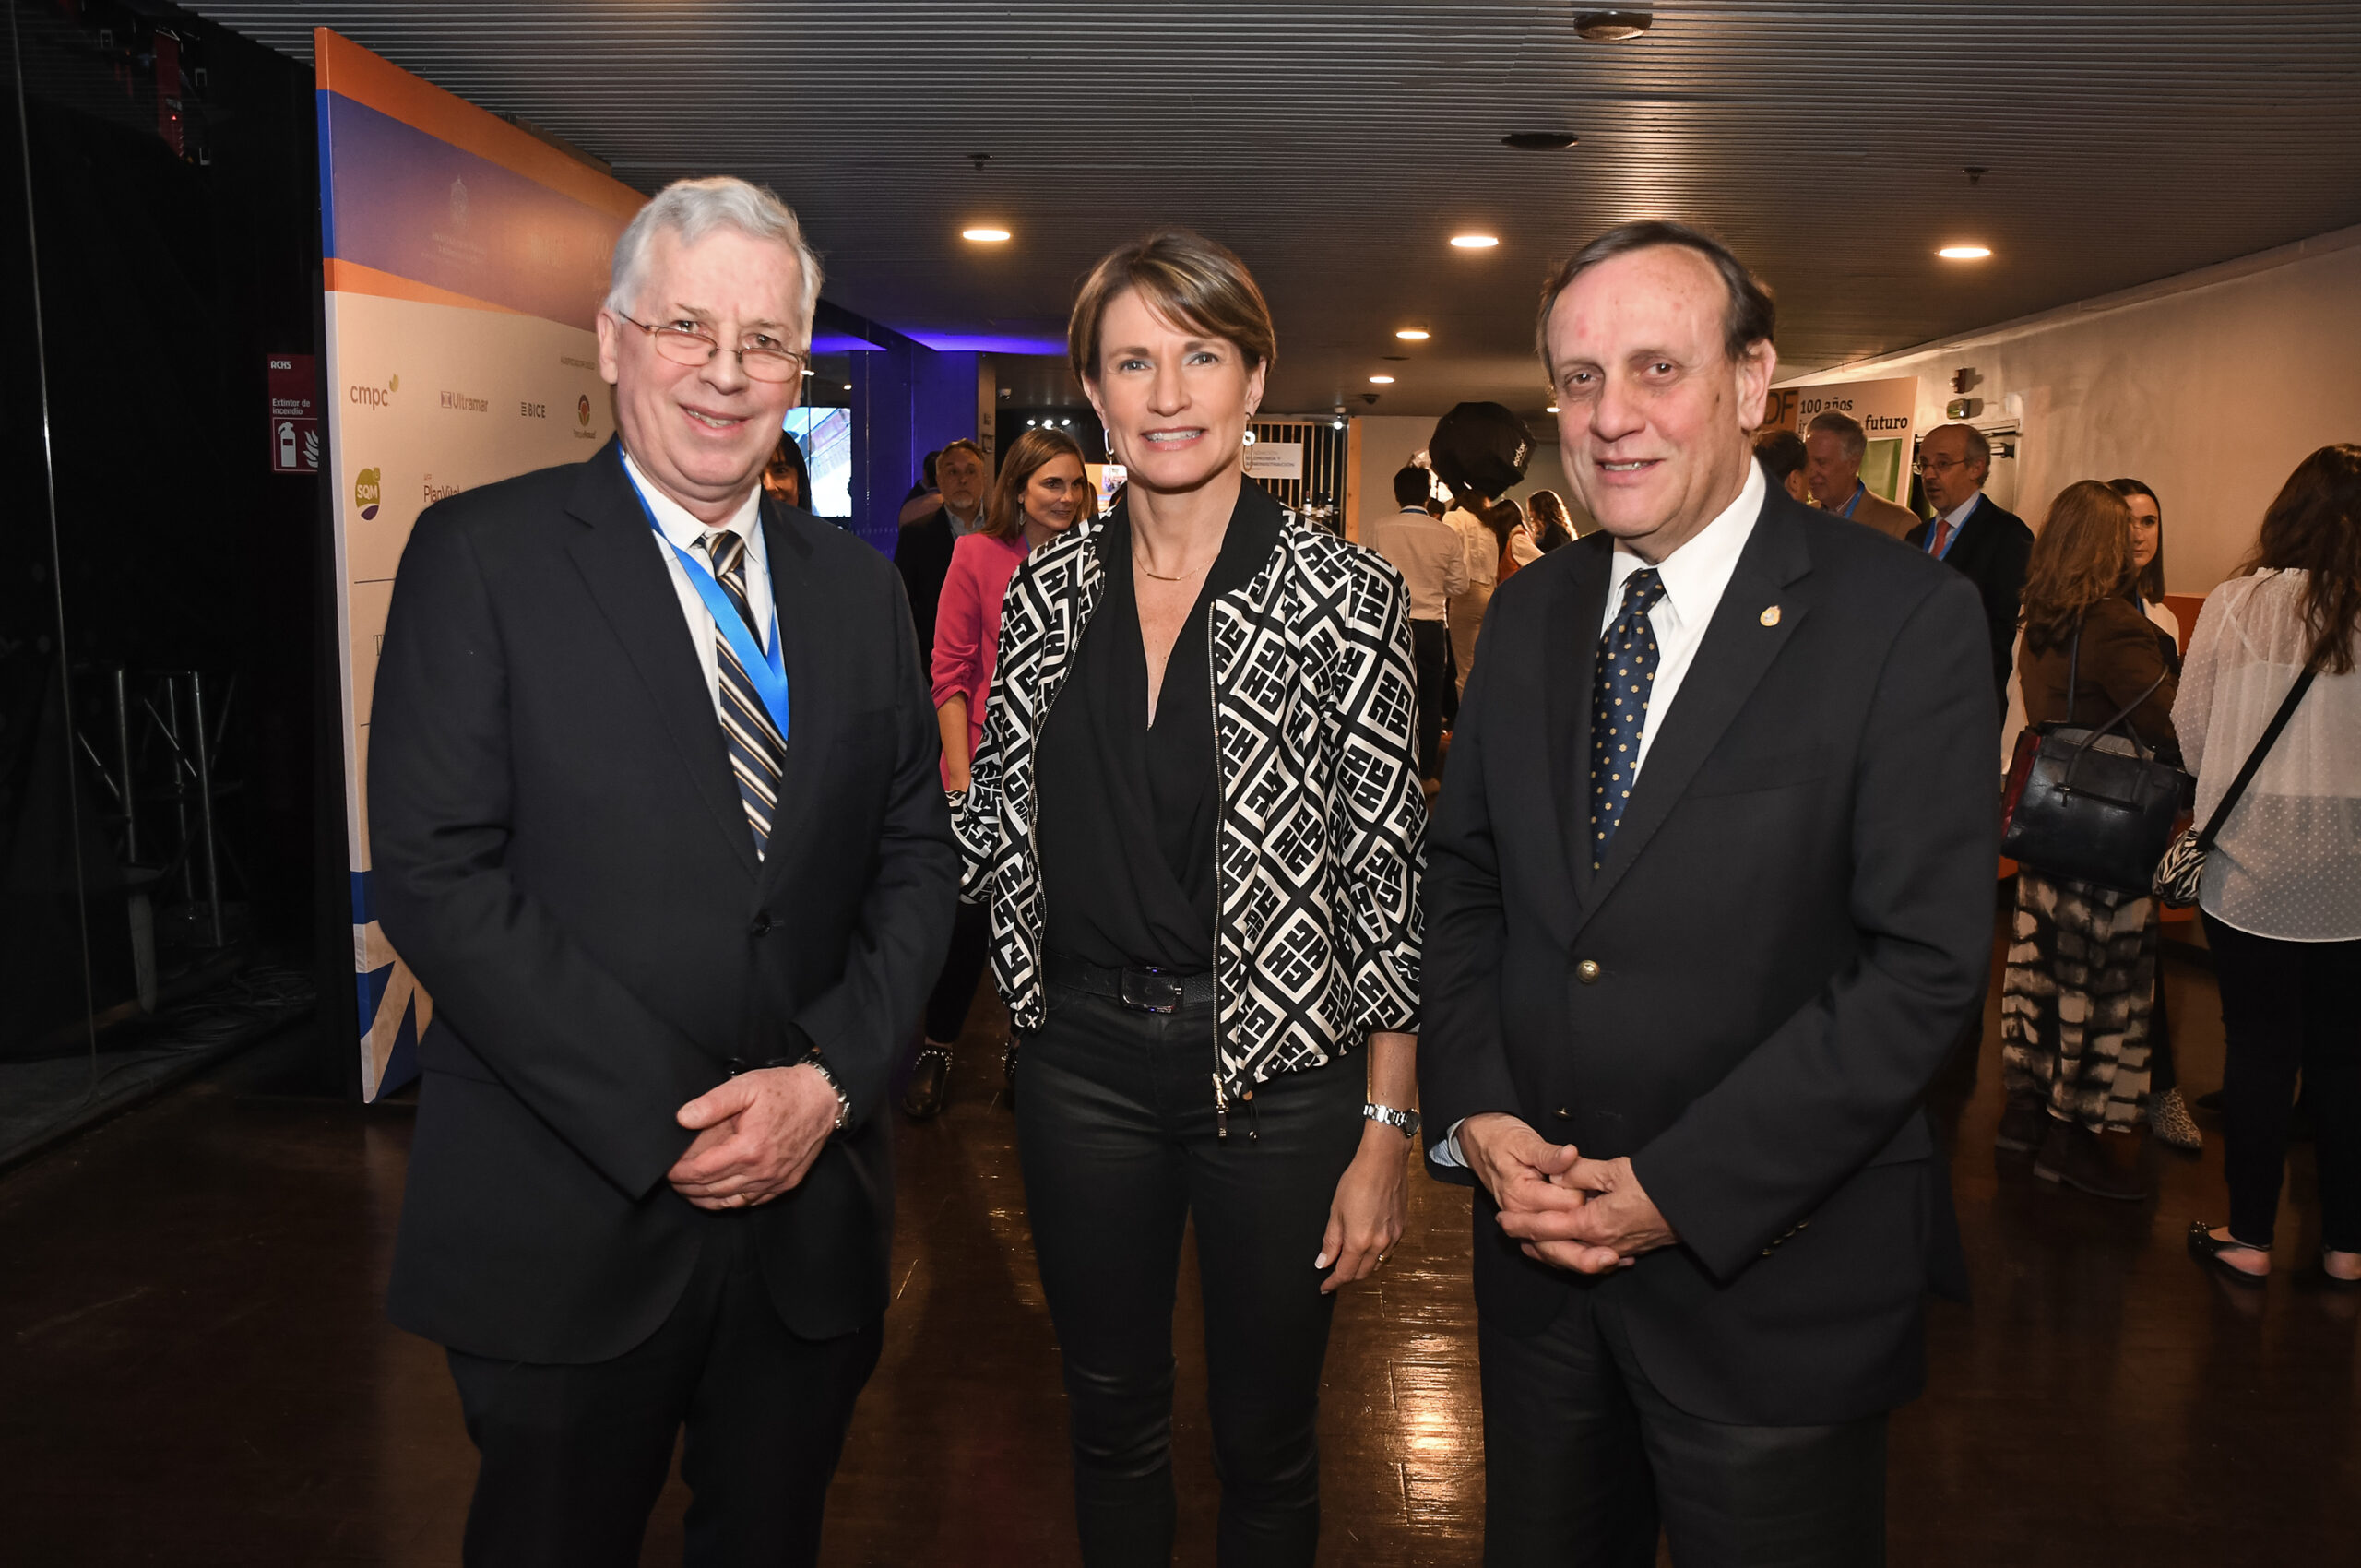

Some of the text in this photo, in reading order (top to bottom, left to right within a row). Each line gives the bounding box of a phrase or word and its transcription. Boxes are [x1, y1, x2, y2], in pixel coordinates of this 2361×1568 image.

[271, 361, 291, 369] ACHS
[272, 398, 300, 407] Extintor
[350, 386, 388, 410] cmpc
[452, 392, 489, 413] Ultramar
[1800, 397, 1853, 414] 100 años
[528, 402, 546, 419] BICE
[1865, 414, 1908, 431] futuro
[357, 484, 378, 501] SQM
